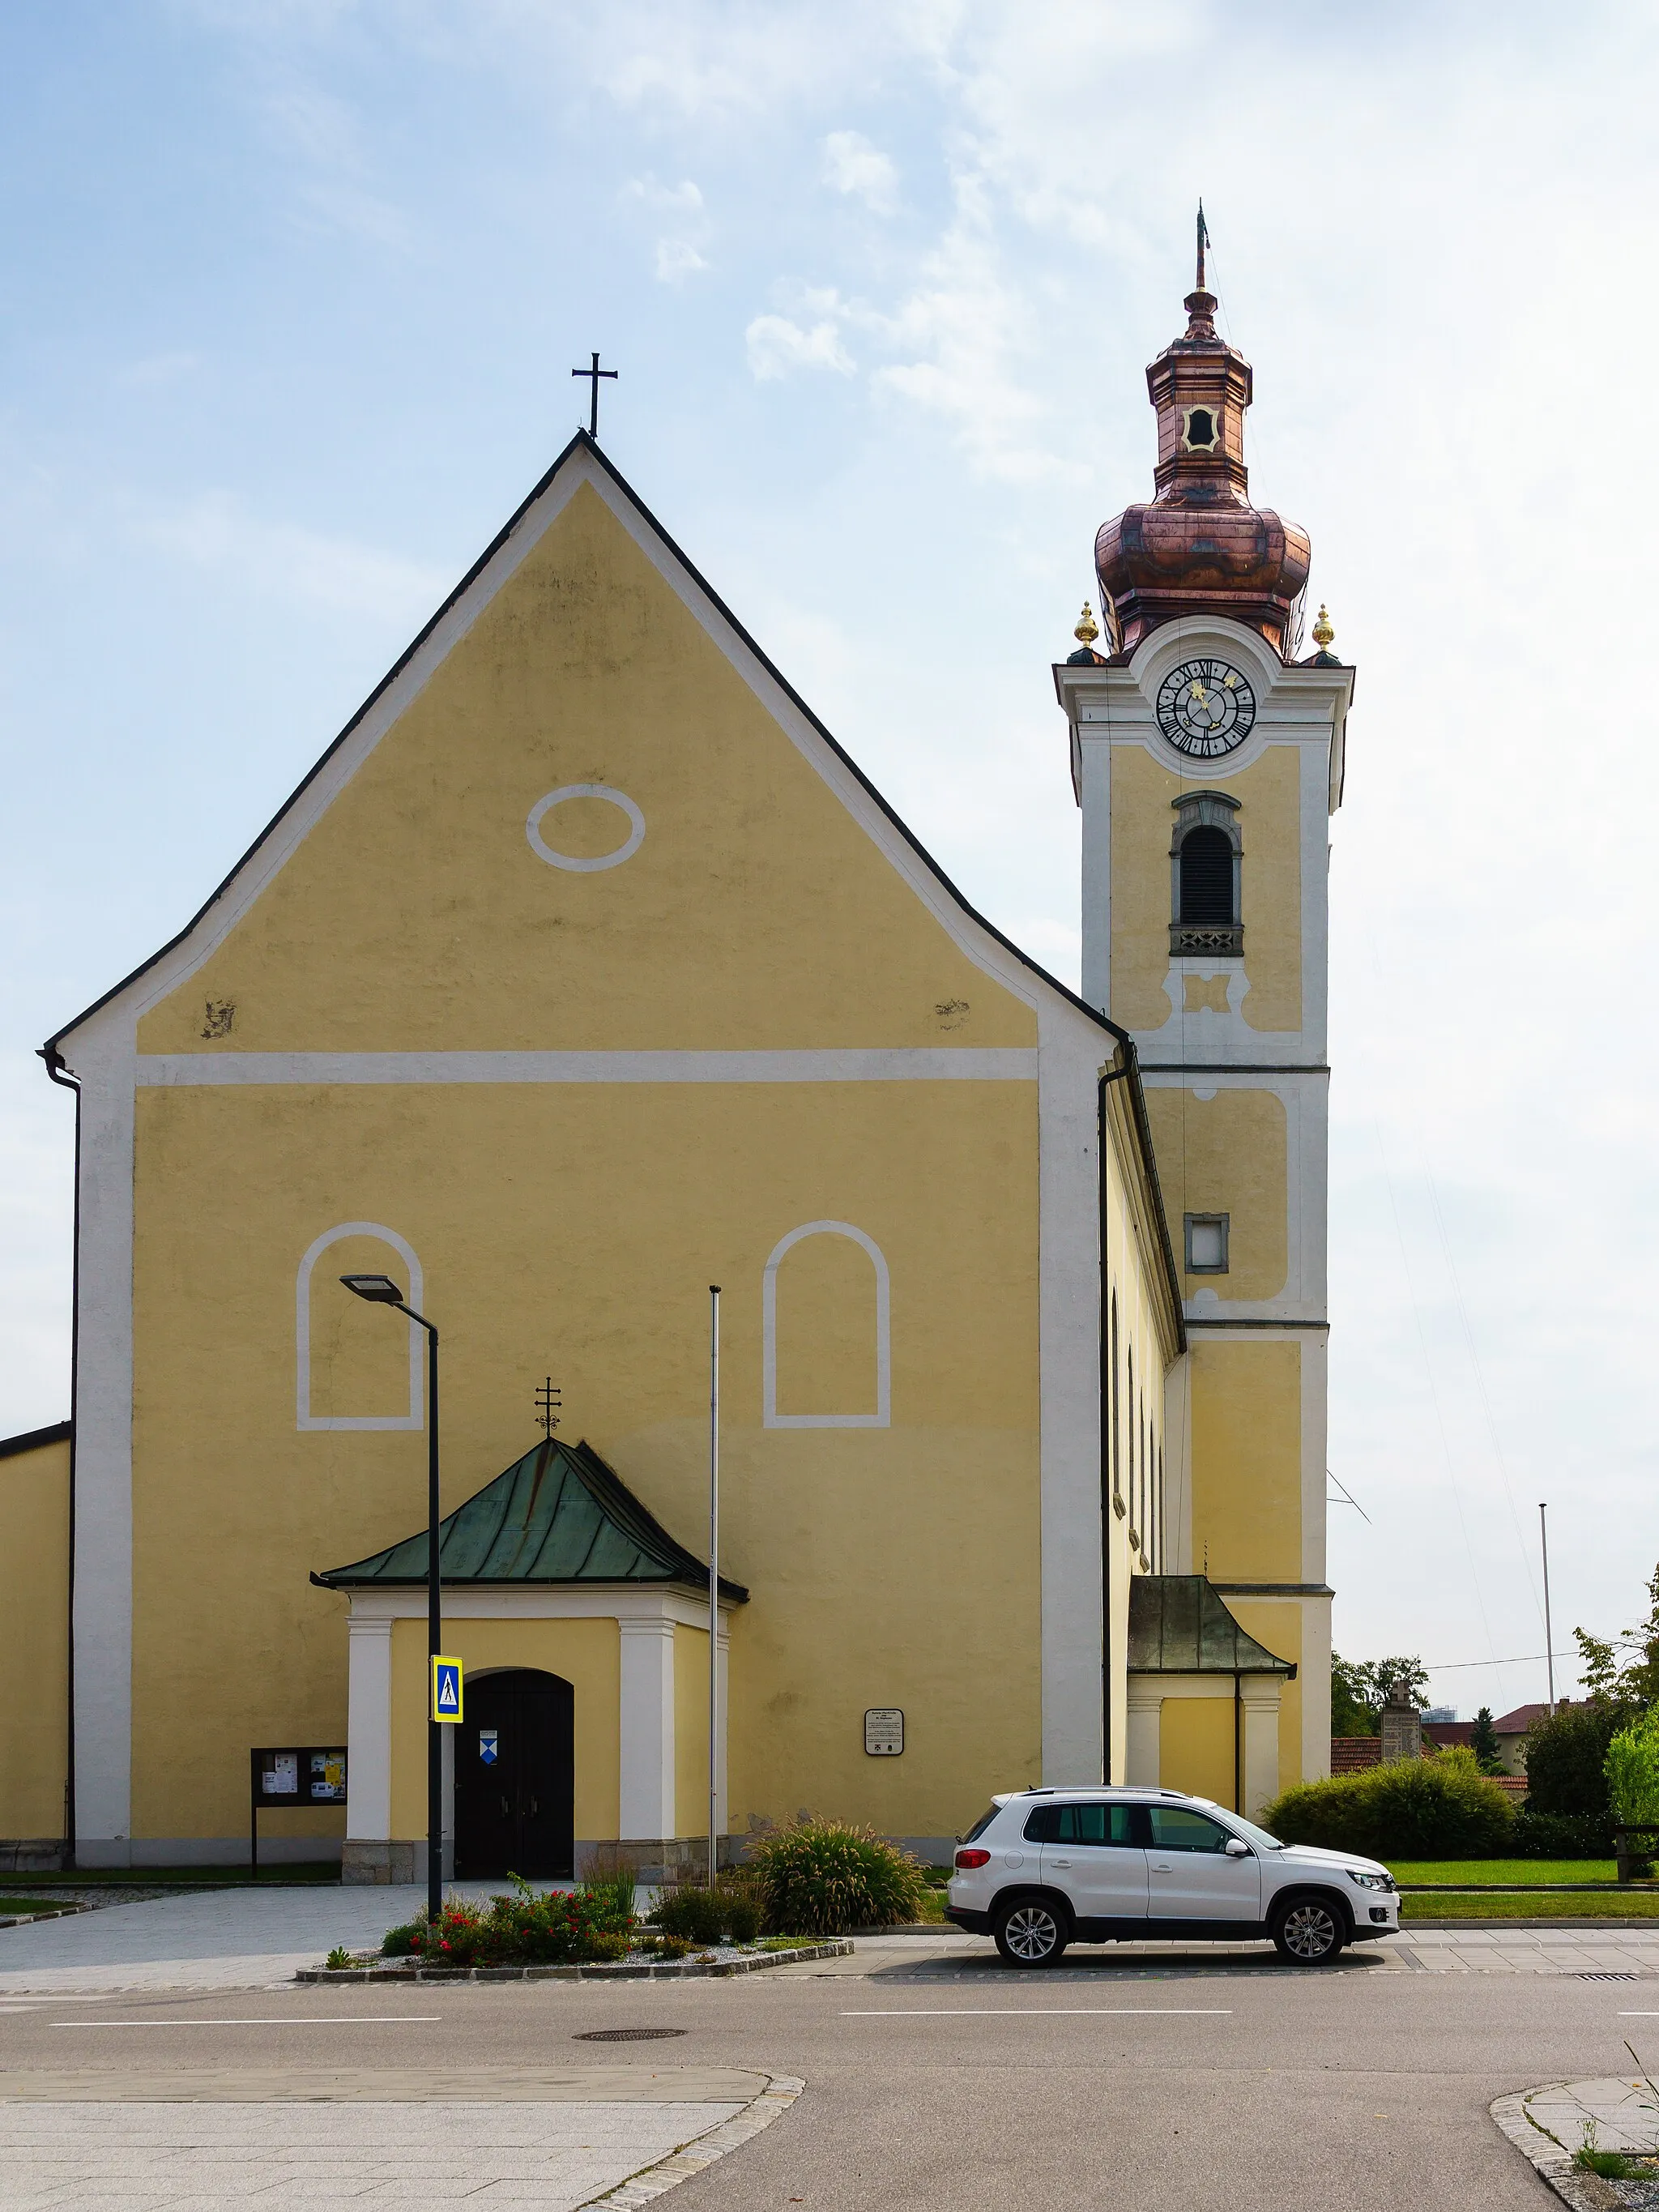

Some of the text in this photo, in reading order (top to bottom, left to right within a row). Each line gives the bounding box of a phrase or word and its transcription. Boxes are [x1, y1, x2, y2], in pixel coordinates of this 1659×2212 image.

[1198, 661, 1213, 677] XII
[1232, 683, 1247, 694] II
[1158, 702, 1175, 714] IX
[1238, 704, 1254, 714] III
[1162, 720, 1182, 738] VIII
[1232, 720, 1249, 737] IIII
[1178, 733, 1193, 751] VII
[1201, 740, 1211, 755] VI
[1222, 736, 1233, 751] V
